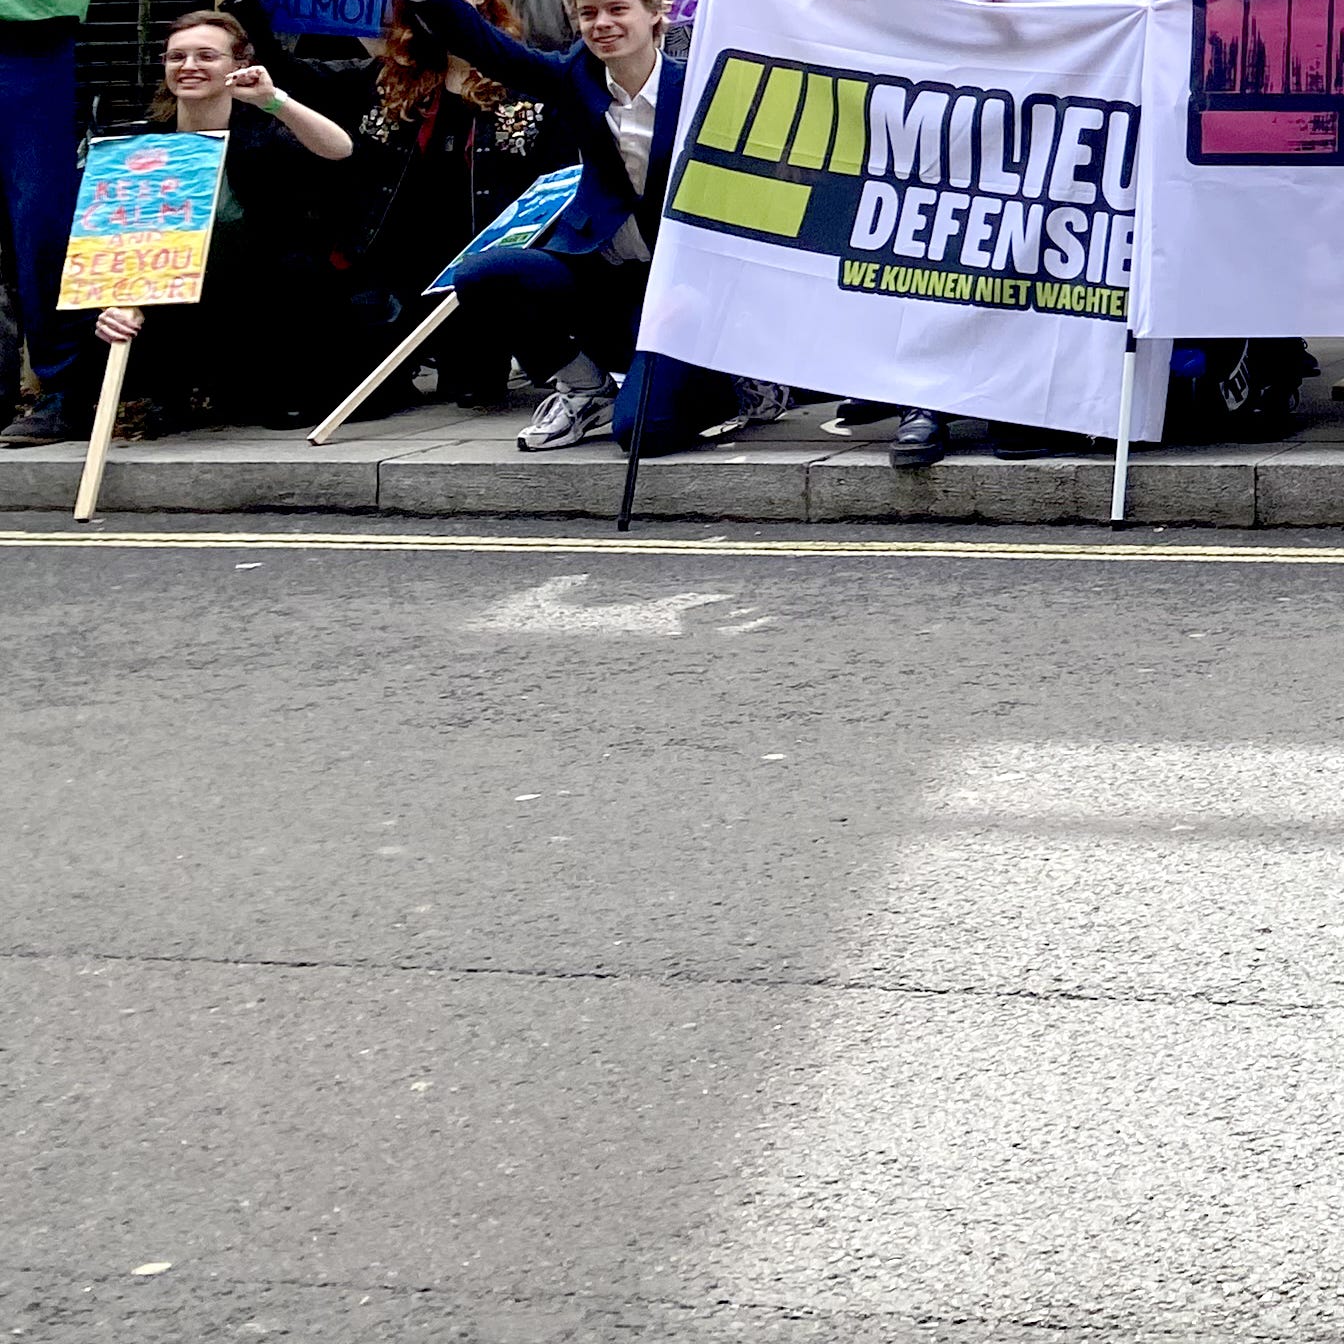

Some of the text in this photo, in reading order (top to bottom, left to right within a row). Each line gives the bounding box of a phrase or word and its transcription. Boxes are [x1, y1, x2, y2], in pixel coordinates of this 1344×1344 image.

[94, 177, 181, 202] KEEP
[81, 200, 194, 231] CALM
[70, 248, 193, 276] SEE YOU
[70, 272, 201, 305] IN COURT
[843, 259, 1129, 319] WE KUNNEN NIET WACHTE
